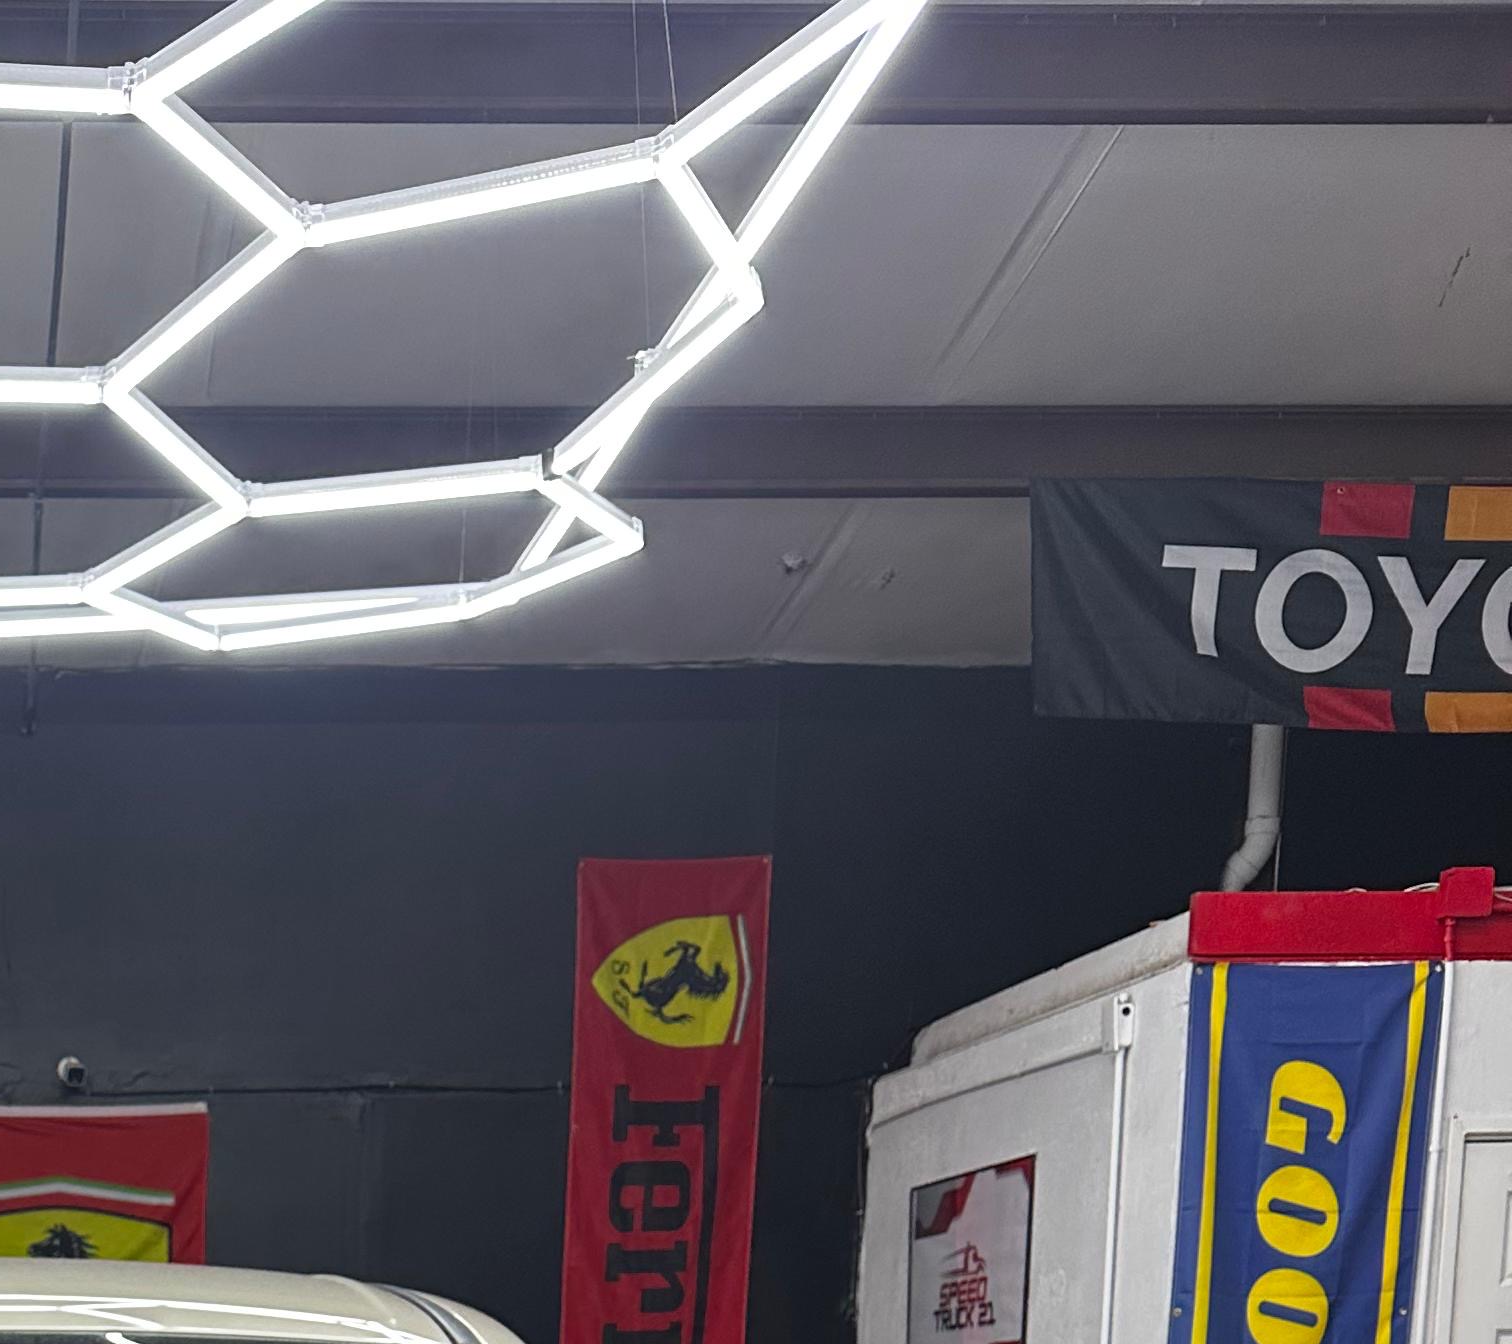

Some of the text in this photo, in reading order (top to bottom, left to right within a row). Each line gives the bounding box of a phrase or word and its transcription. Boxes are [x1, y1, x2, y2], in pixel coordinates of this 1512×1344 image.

[1161, 544, 1512, 675] TOY
[939, 1276, 988, 1308] SPEED
[933, 1303, 975, 1333] TRUCK
